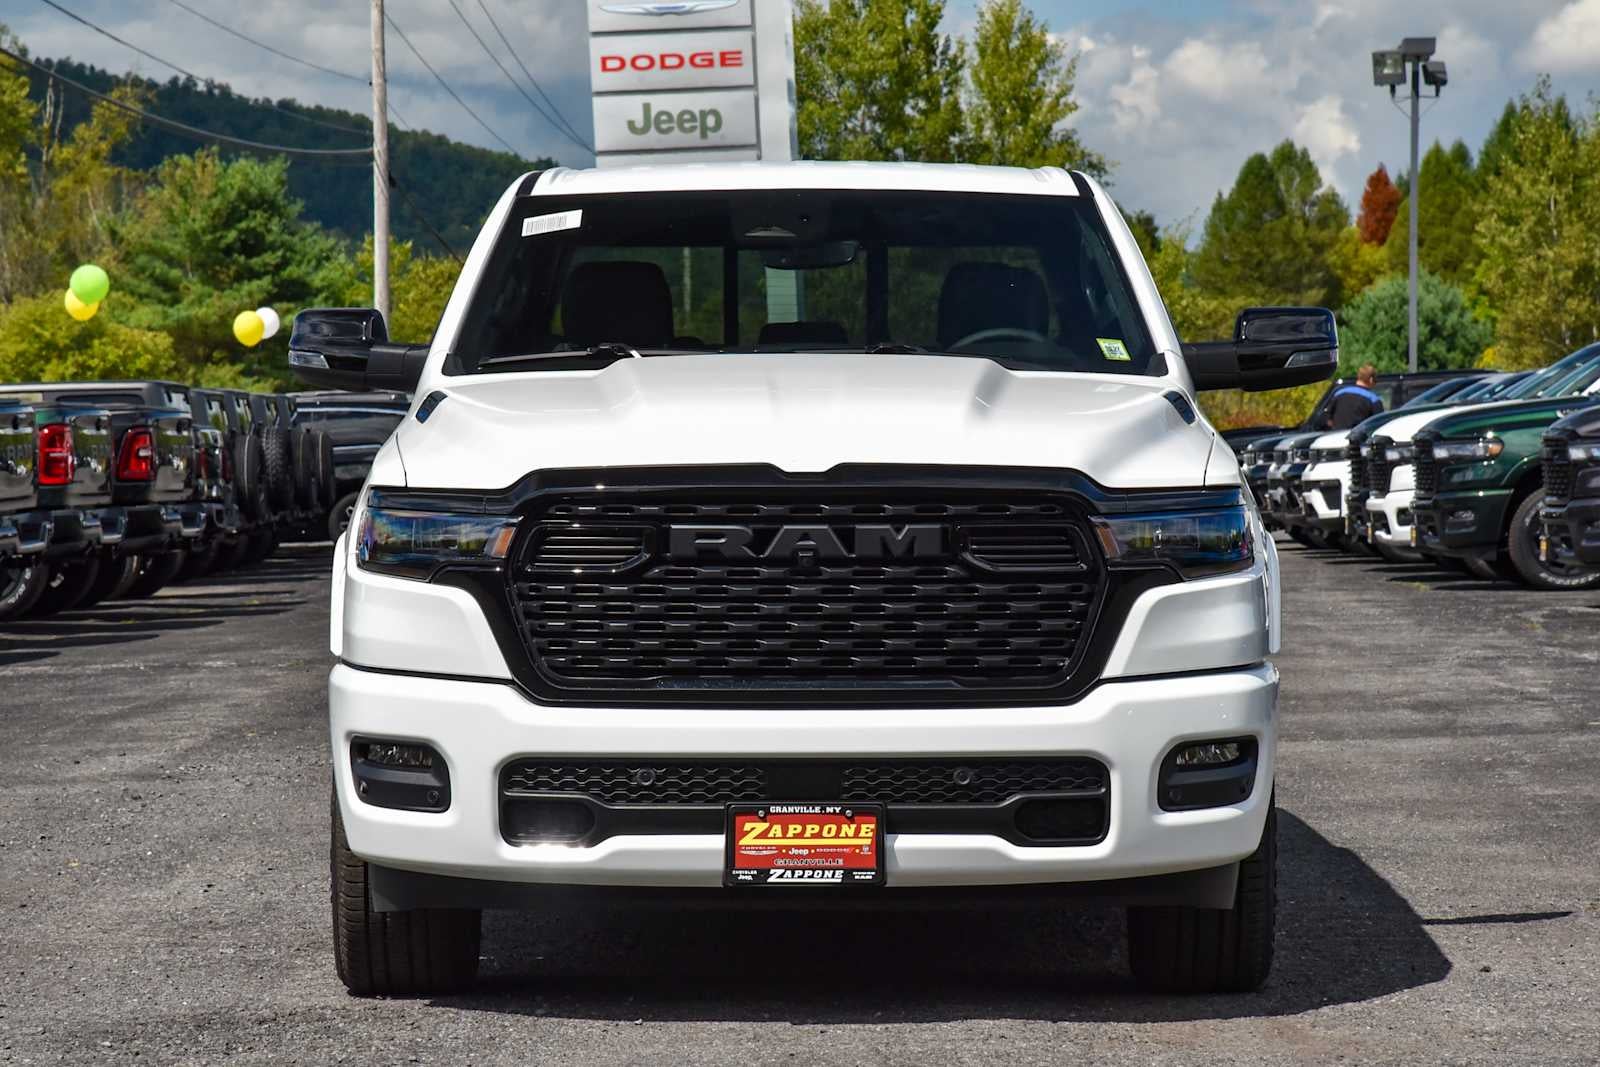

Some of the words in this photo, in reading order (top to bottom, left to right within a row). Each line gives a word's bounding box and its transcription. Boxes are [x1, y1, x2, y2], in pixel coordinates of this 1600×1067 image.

[600, 51, 743, 72] DODGE
[627, 102, 723, 139] Jeep
[670, 524, 942, 558] RAM
[825, 806, 842, 814] NY
[738, 822, 875, 845] ZAPPONE
[788, 847, 809, 856] Jeep
[773, 858, 844, 866] GRANVILLE
[767, 869, 844, 883] ZAPPONE
